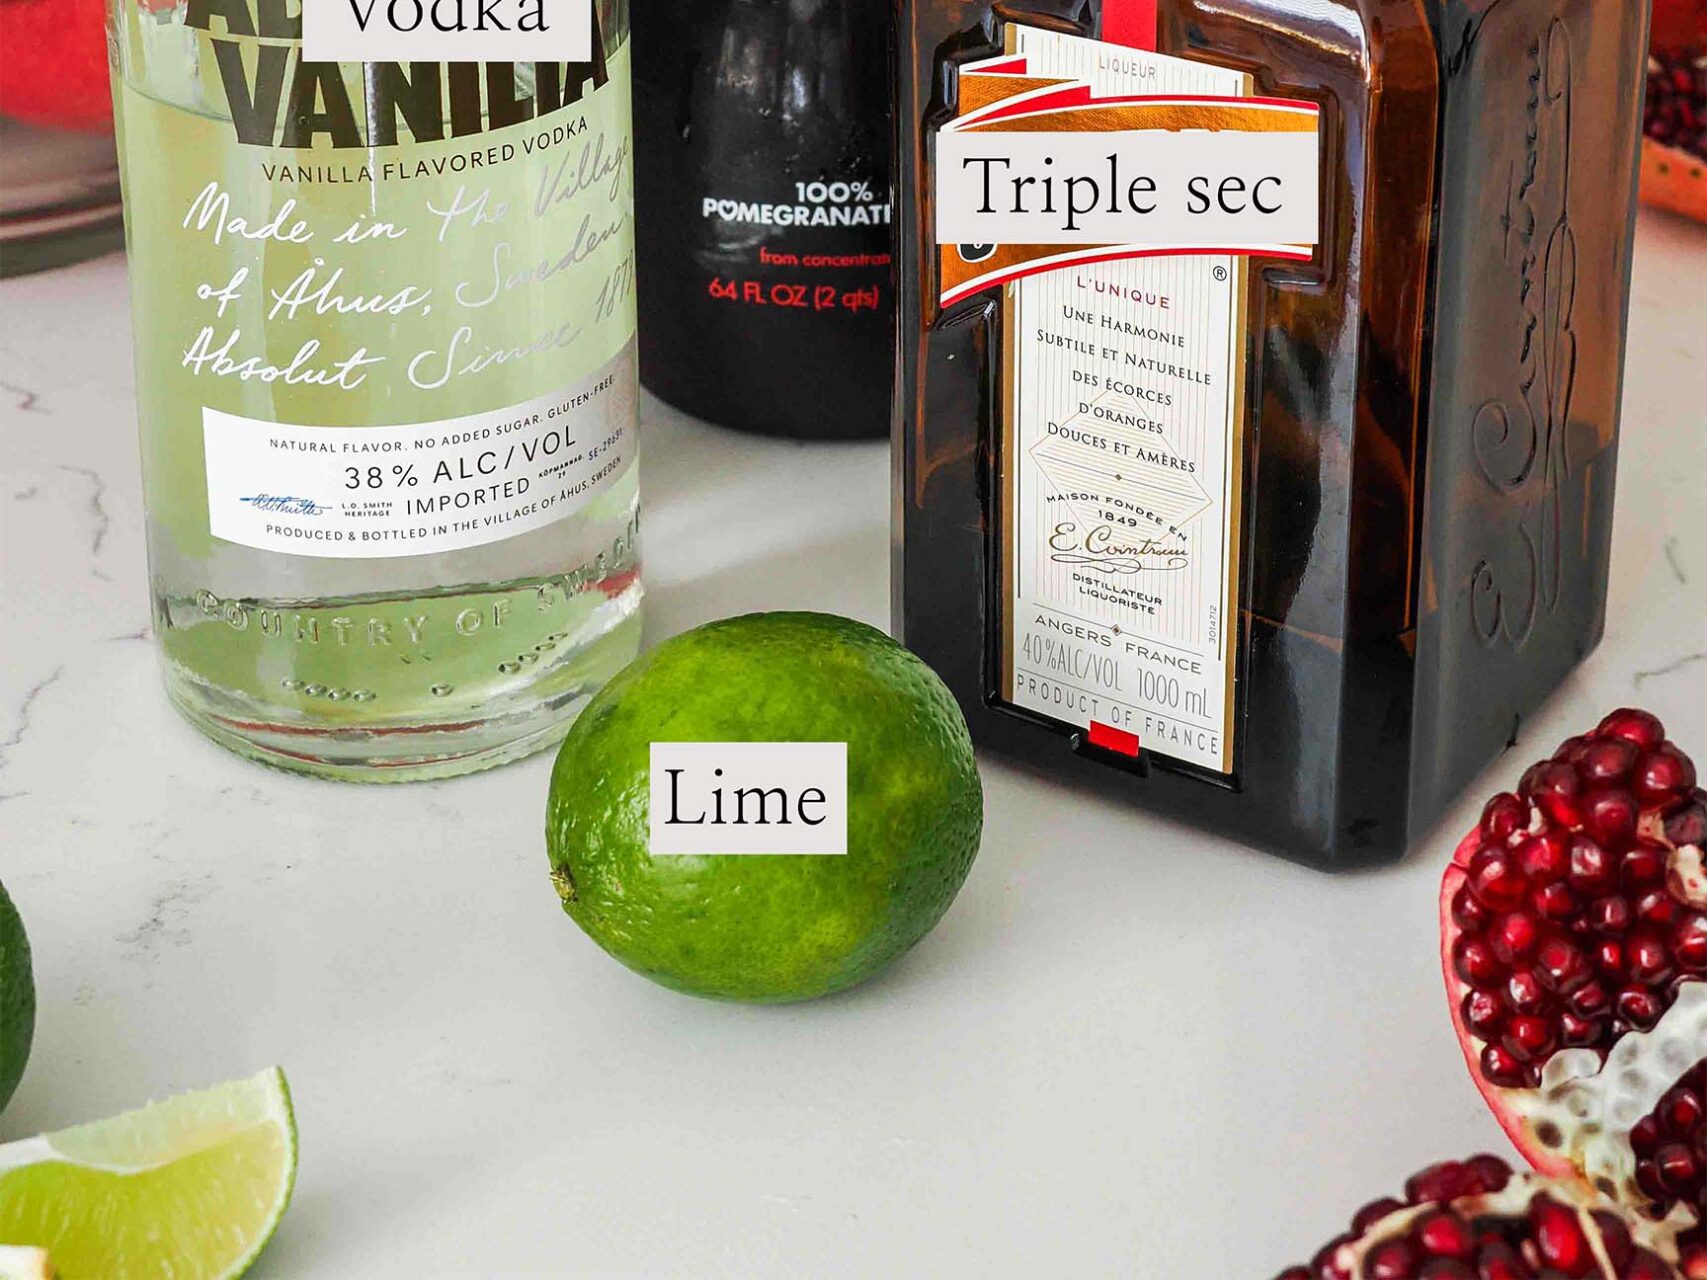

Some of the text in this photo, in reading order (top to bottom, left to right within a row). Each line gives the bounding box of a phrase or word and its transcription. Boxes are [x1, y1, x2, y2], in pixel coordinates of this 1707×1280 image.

[1098, 55, 1156, 81] LIQUEUR
[261, 116, 588, 185] VANILLA FLAVORED VODKA
[795, 181, 874, 204] 100%
[182, 181, 314, 245] Made
[333, 215, 409, 244] in
[427, 186, 509, 243] the
[759, 247, 891, 268] from concentrat
[197, 267, 249, 319] of
[708, 278, 879, 312] 64 FL OZ (2 qts)
[1076, 275, 1170, 309] L'UNIQUE
[1063, 305, 1185, 348] UNE HARMONIE
[182, 326, 386, 390] Absolut
[408, 326, 582, 389] Since
[1037, 328, 1212, 385] SUBTILE ET NATURELLE
[1072, 370, 1172, 406] DES ÉCORCES
[269, 437, 336, 454] NATURAL
[342, 440, 408, 454] FLAVOR.
[414, 437, 436, 450] NO
[441, 428, 491, 446] ADDED
[496, 414, 543, 436] SUGAR.
[1079, 402, 1163, 434] D'ORANGES
[344, 425, 577, 490] 38% ALC/VOL
[1047, 421, 1195, 473] DOUCES ET AMÈRES
[266, 523, 343, 541] PRODUCED
[348, 531, 356, 541] &
[362, 528, 427, 541] BOTTLED
[433, 526, 447, 536] IN
[453, 519, 479, 532] THE
[483, 503, 538, 526] VILLAGE
[541, 495, 557, 509] OF
[591, 455, 622, 486] SWEDEN
[363, 501, 393, 509] SMITH
[407, 476, 531, 516] IMPORTED
[1047, 493, 1188, 542] MAISON FONDÉE EN
[1048, 521, 1083, 552] E.
[1098, 509, 1138, 528] 1849
[1072, 573, 1163, 606] DISTILLATEUR
[1079, 586, 1155, 615] LIQUORISTE
[195, 588, 427, 647] COUNTRY
[455, 599, 512, 636] OF
[1034, 614, 1202, 675] ANGERS FRANCE
[1137, 668, 1179, 708] 1000
[1017, 674, 1218, 755] PRODUCT OF FRANCE
